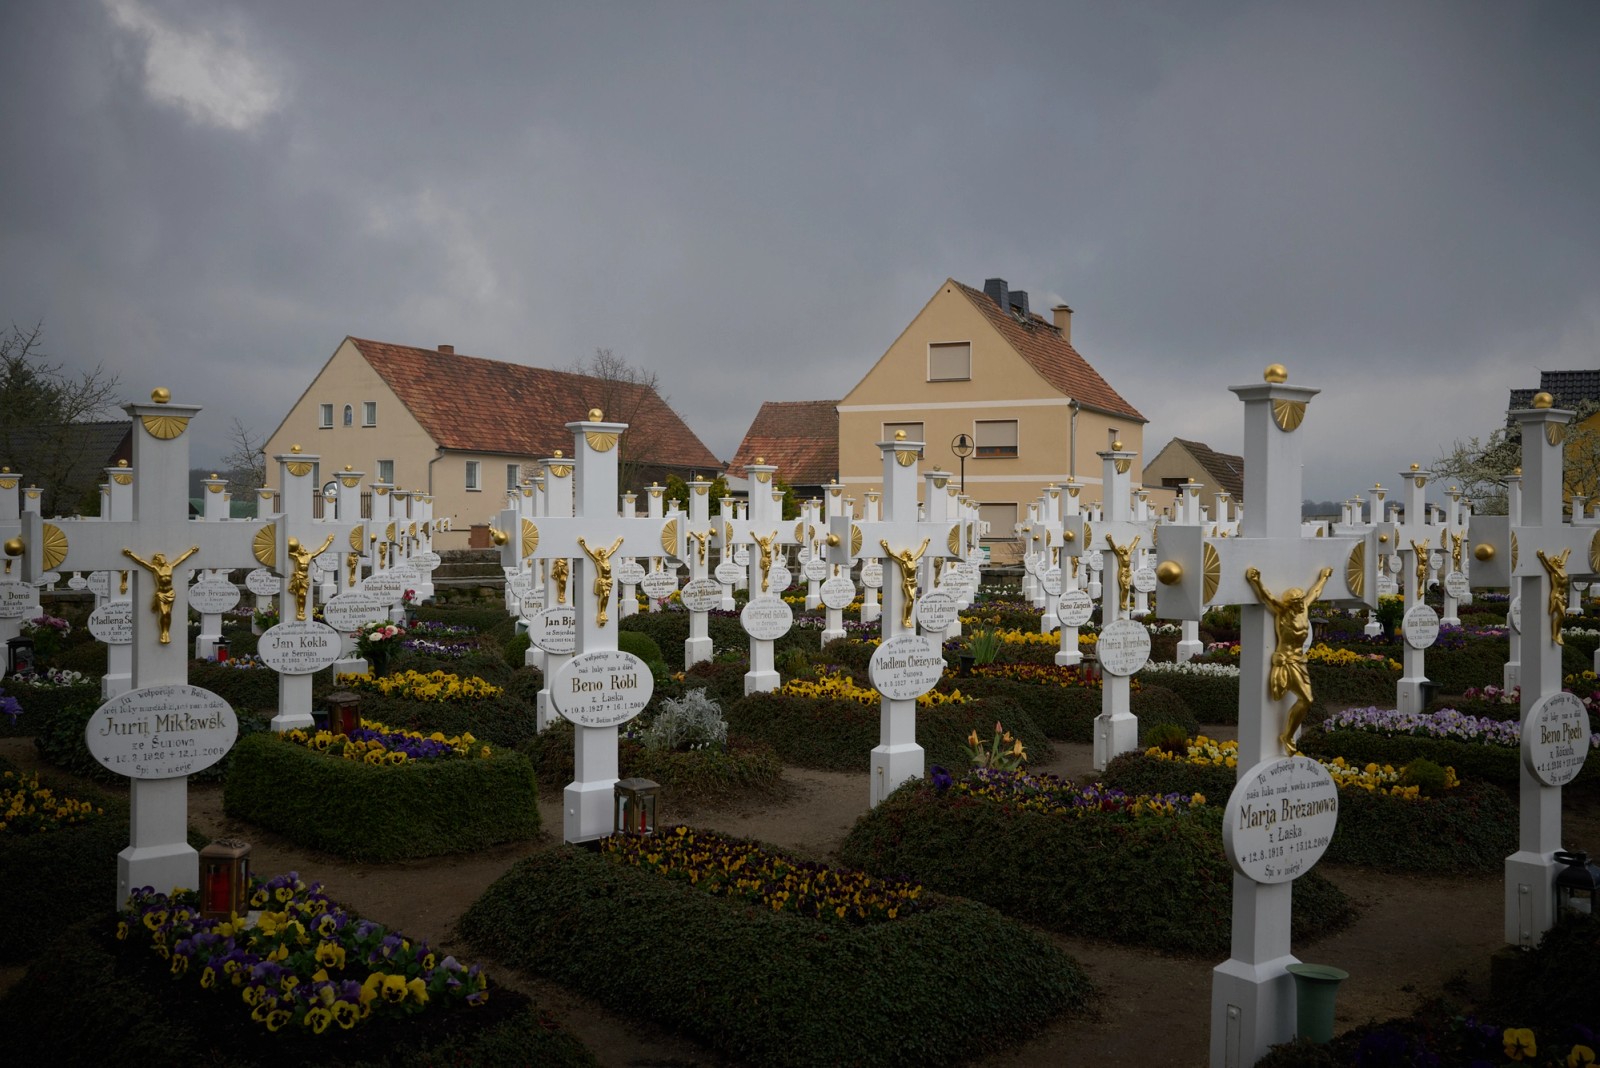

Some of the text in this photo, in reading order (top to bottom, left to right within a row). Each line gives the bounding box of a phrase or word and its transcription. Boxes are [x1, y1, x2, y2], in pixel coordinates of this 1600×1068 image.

[91, 616, 123, 625] Madlena
[545, 617, 576, 629] Jan Bja
[272, 636, 327, 649] Jan Kokla
[876, 656, 907, 670] Madlena
[571, 677, 603, 693] Beno
[602, 692, 624, 703] Łaska
[99, 712, 226, 738] Jurij Mikławšk
[1540, 720, 1582, 745] Beno Pjech
[151, 735, 194, 749] Šunowa
[1257, 774, 1266, 785] Tu
[1240, 803, 1277, 831] Marja
[1269, 824, 1302, 843] z Łaska
